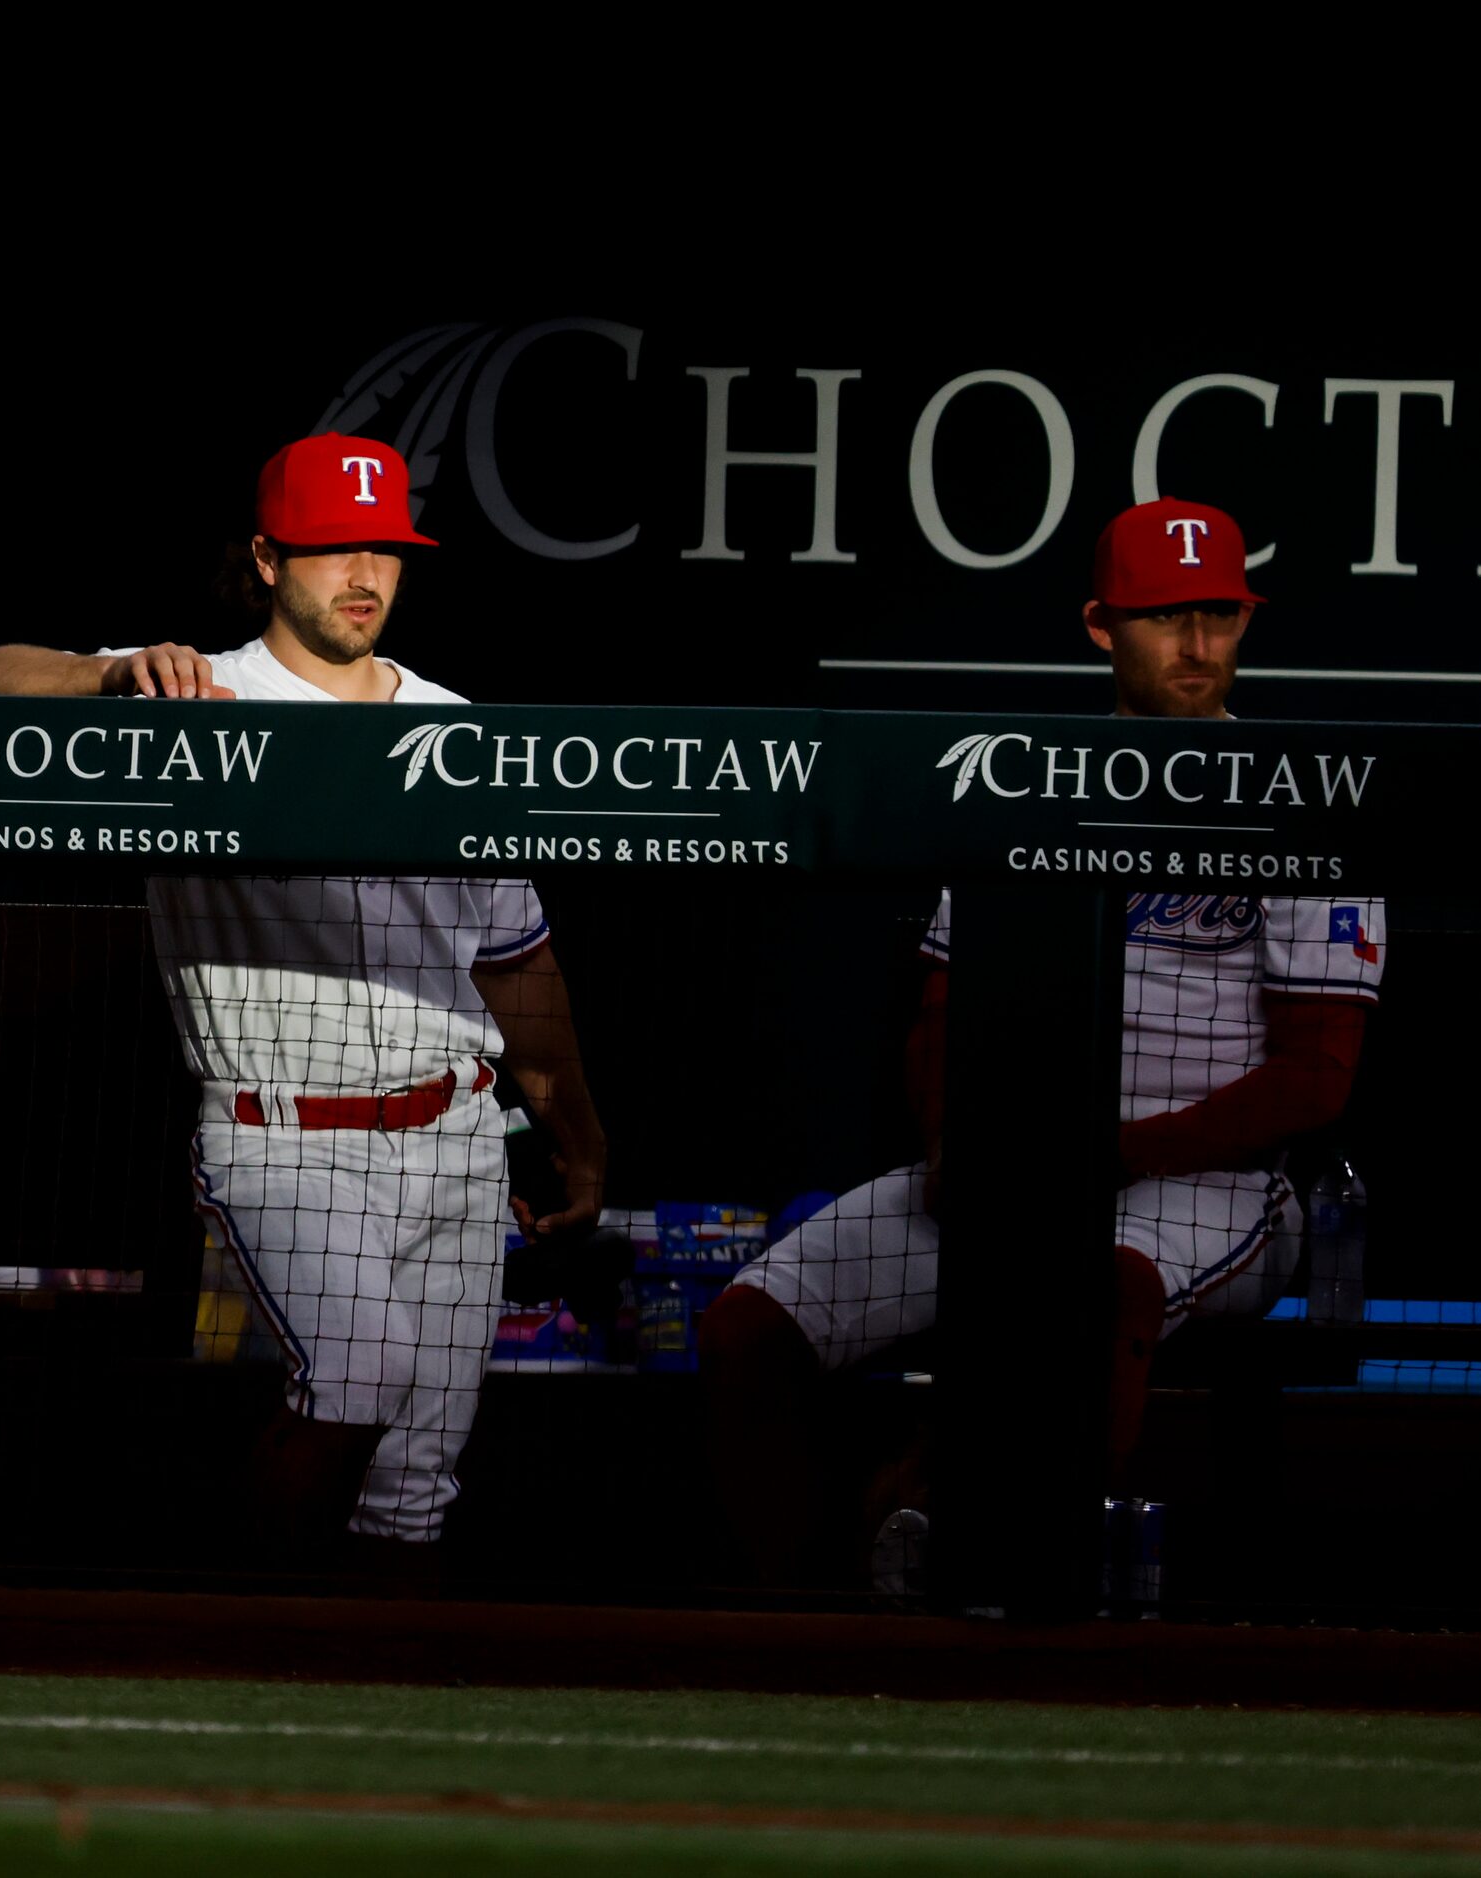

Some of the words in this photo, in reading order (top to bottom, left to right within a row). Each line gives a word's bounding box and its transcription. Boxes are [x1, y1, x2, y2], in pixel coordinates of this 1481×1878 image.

[464, 315, 1481, 576] CHOCT
[342, 456, 383, 505] T
[1165, 518, 1209, 567] T
[431, 722, 822, 792] CHOCTAW
[981, 733, 1376, 807] CHOCTAW
[67, 828, 85, 851] &
[98, 829, 241, 855] RESORTS
[459, 835, 602, 861] CASINOS
[615, 838, 633, 862] &
[646, 839, 789, 864] RESORTS
[1008, 847, 1152, 874] CASINOS
[1167, 853, 1185, 876] &
[1198, 853, 1343, 879] RESORTS
